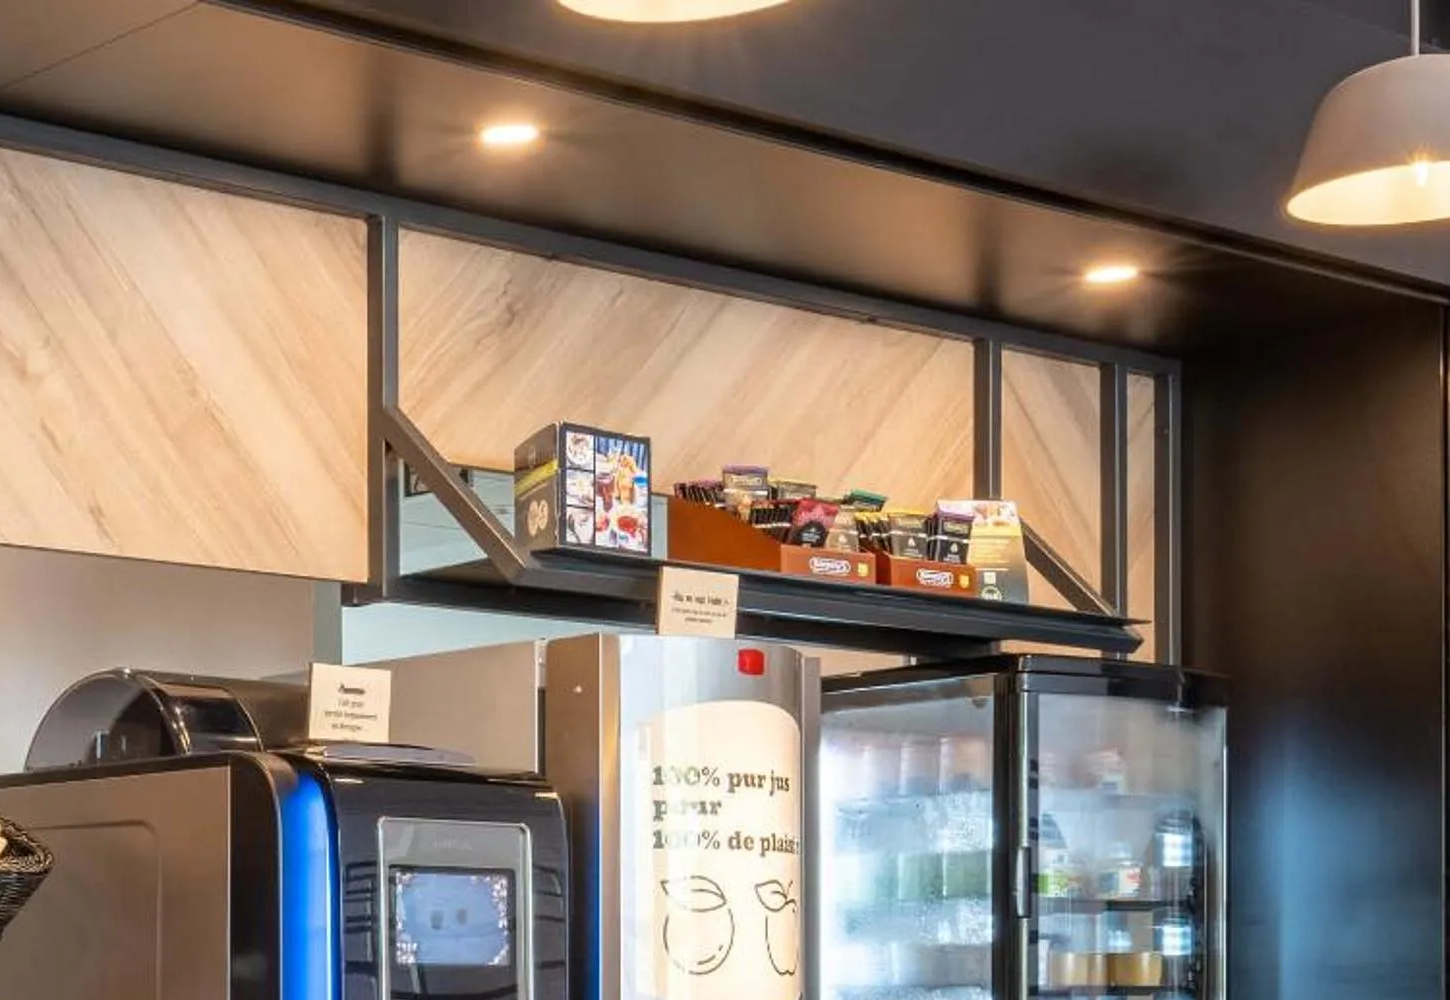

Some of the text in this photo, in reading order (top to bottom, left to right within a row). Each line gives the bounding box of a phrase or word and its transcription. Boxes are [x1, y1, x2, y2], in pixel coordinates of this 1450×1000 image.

[726, 771, 766, 793] pur
[769, 768, 790, 796] jus
[728, 831, 755, 851] de
